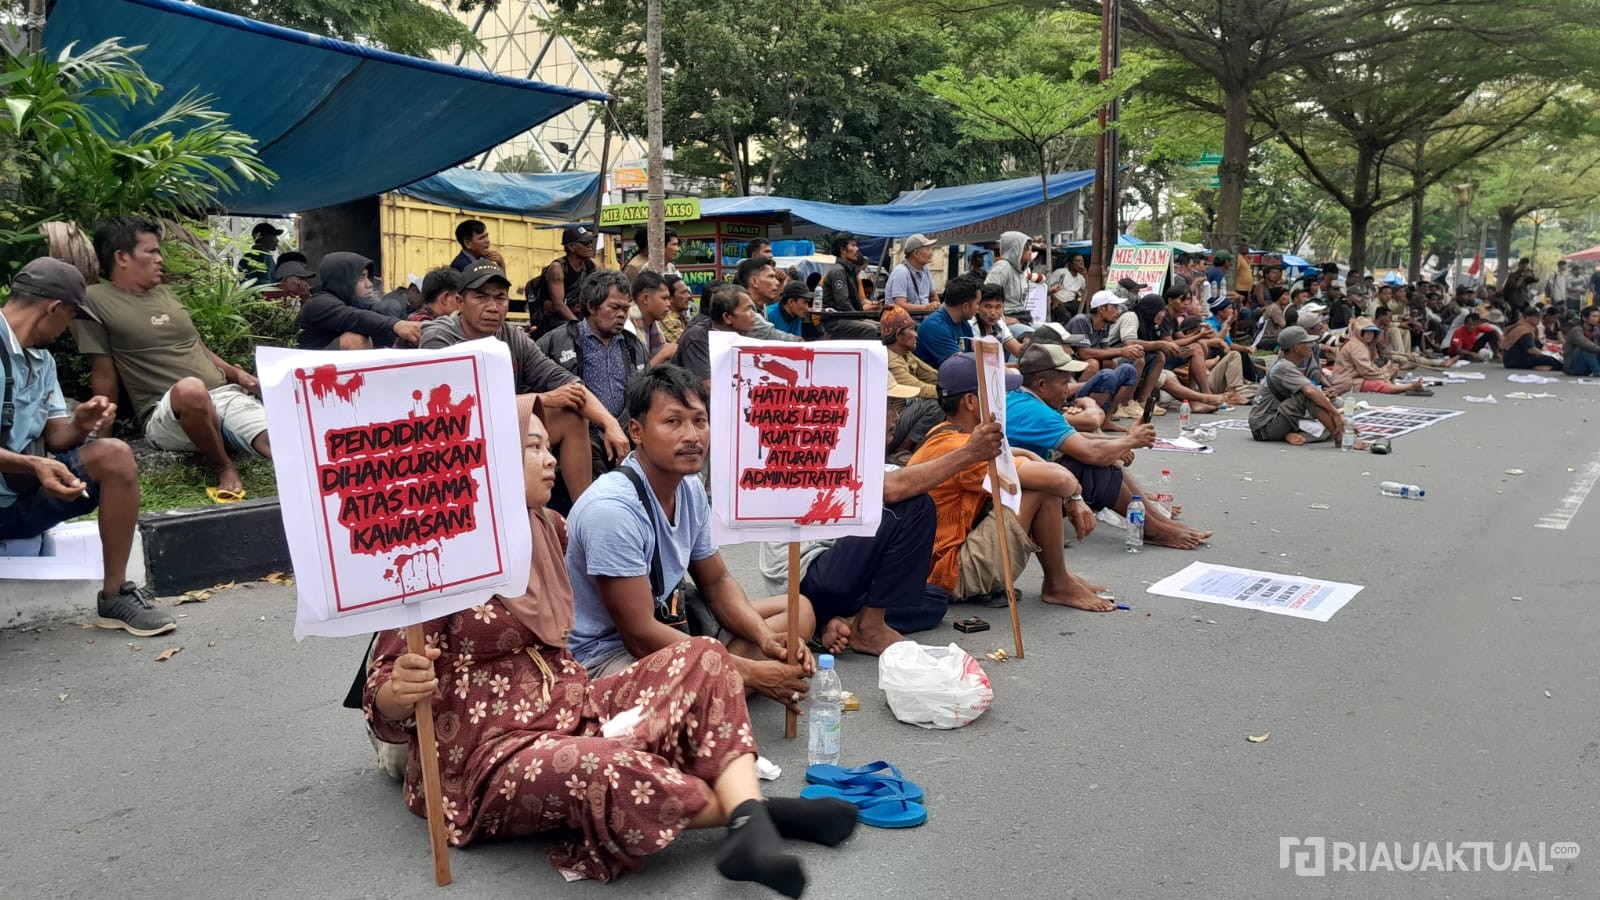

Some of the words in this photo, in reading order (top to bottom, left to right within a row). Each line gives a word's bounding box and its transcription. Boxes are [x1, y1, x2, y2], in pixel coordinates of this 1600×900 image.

[602, 208, 619, 222] MIE
[623, 206, 649, 220] AYAM
[665, 203, 693, 217] AKSO
[728, 224, 760, 234] PANSIT
[1114, 249, 1134, 264] MIE
[1136, 249, 1167, 264] AYAM
[1136, 270, 1163, 283] PANSIT
[753, 389, 786, 404] HATI
[789, 389, 844, 405] NURANI
[752, 409, 799, 425] HARUS
[803, 409, 846, 424] LEBIH
[329, 414, 468, 458] PENDIDIKAN
[761, 430, 800, 445] KUAT
[801, 430, 835, 445] DARI
[768, 451, 827, 465] ATURAN
[322, 442, 482, 492] DIHANCURKAN
[742, 470, 851, 486] ADMINISTRATIF!
[342, 489, 403, 521] ATAS
[409, 474, 473, 506] NAMA
[353, 507, 473, 550] KAWASAN!
